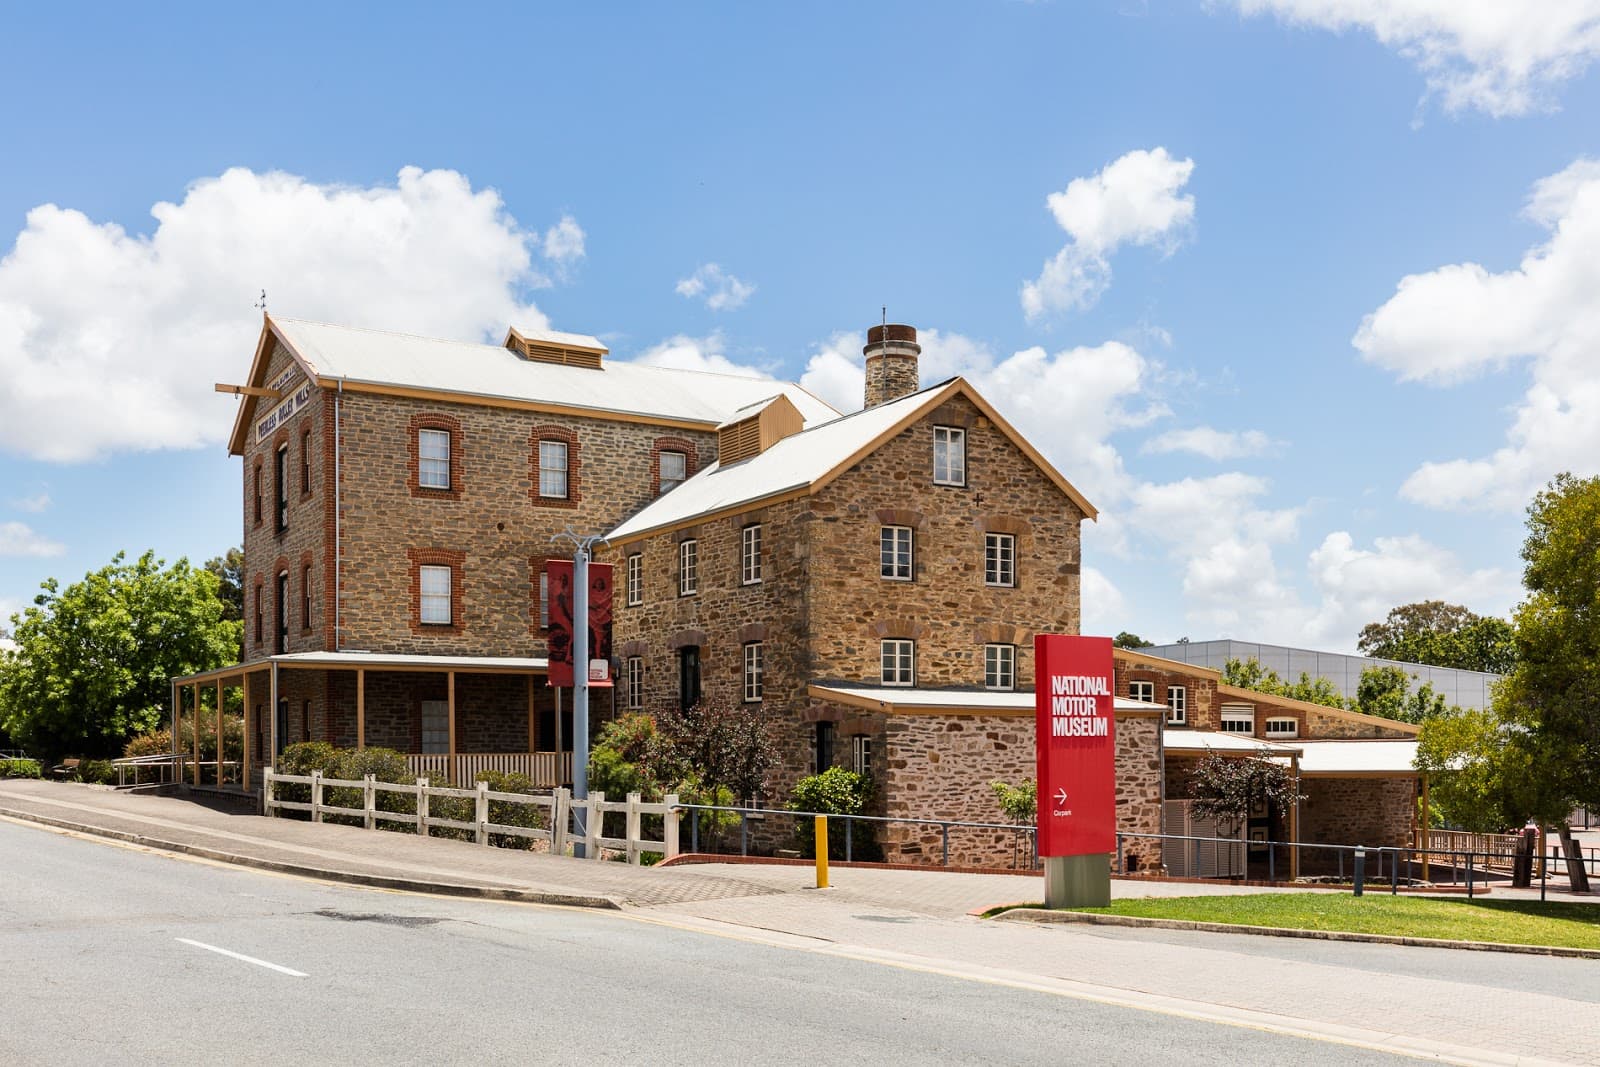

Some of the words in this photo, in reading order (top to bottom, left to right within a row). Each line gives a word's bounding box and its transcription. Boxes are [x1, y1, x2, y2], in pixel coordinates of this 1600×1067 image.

[1052, 675, 1110, 696] NATIONAL
[1052, 696, 1097, 716] MOTOR
[1052, 717, 1108, 737] MUSEUM
